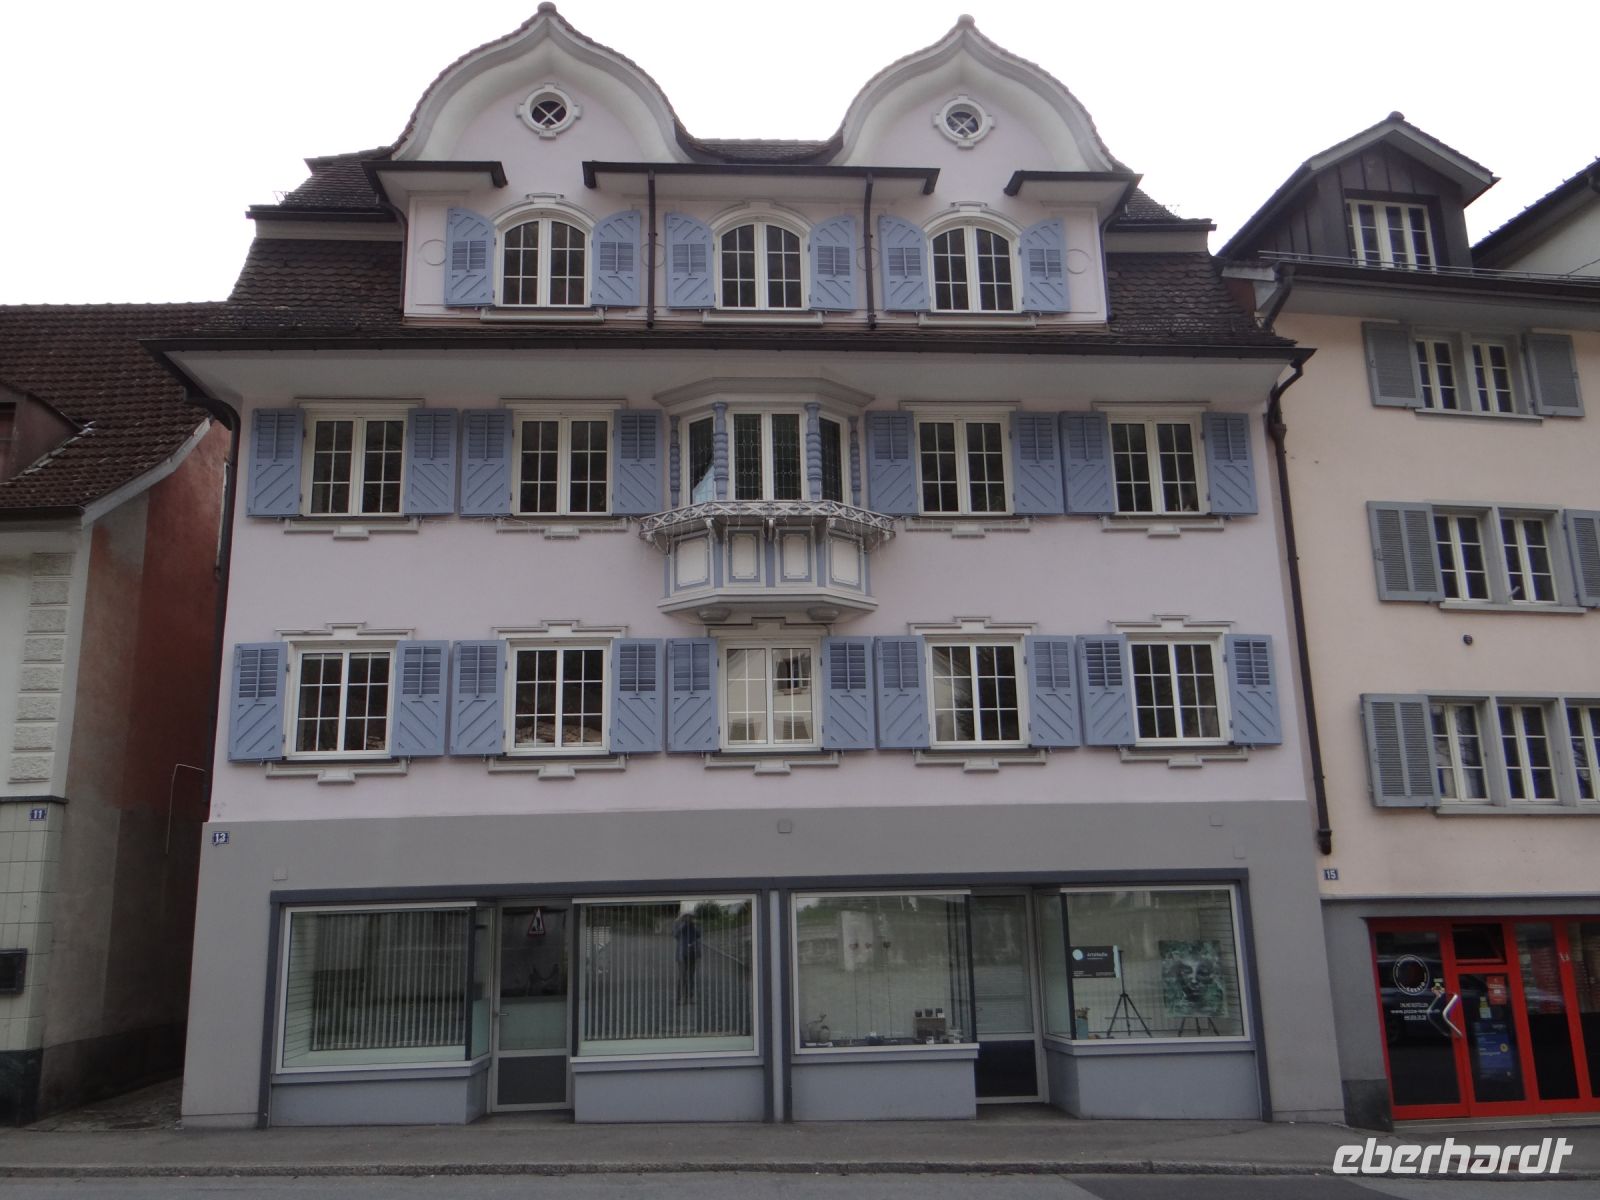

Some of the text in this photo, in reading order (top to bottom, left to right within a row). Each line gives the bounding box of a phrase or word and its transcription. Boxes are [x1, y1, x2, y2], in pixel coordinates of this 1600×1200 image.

[33, 810, 42, 819] 11
[215, 832, 226, 842] 13
[1326, 870, 1336, 879] 15
